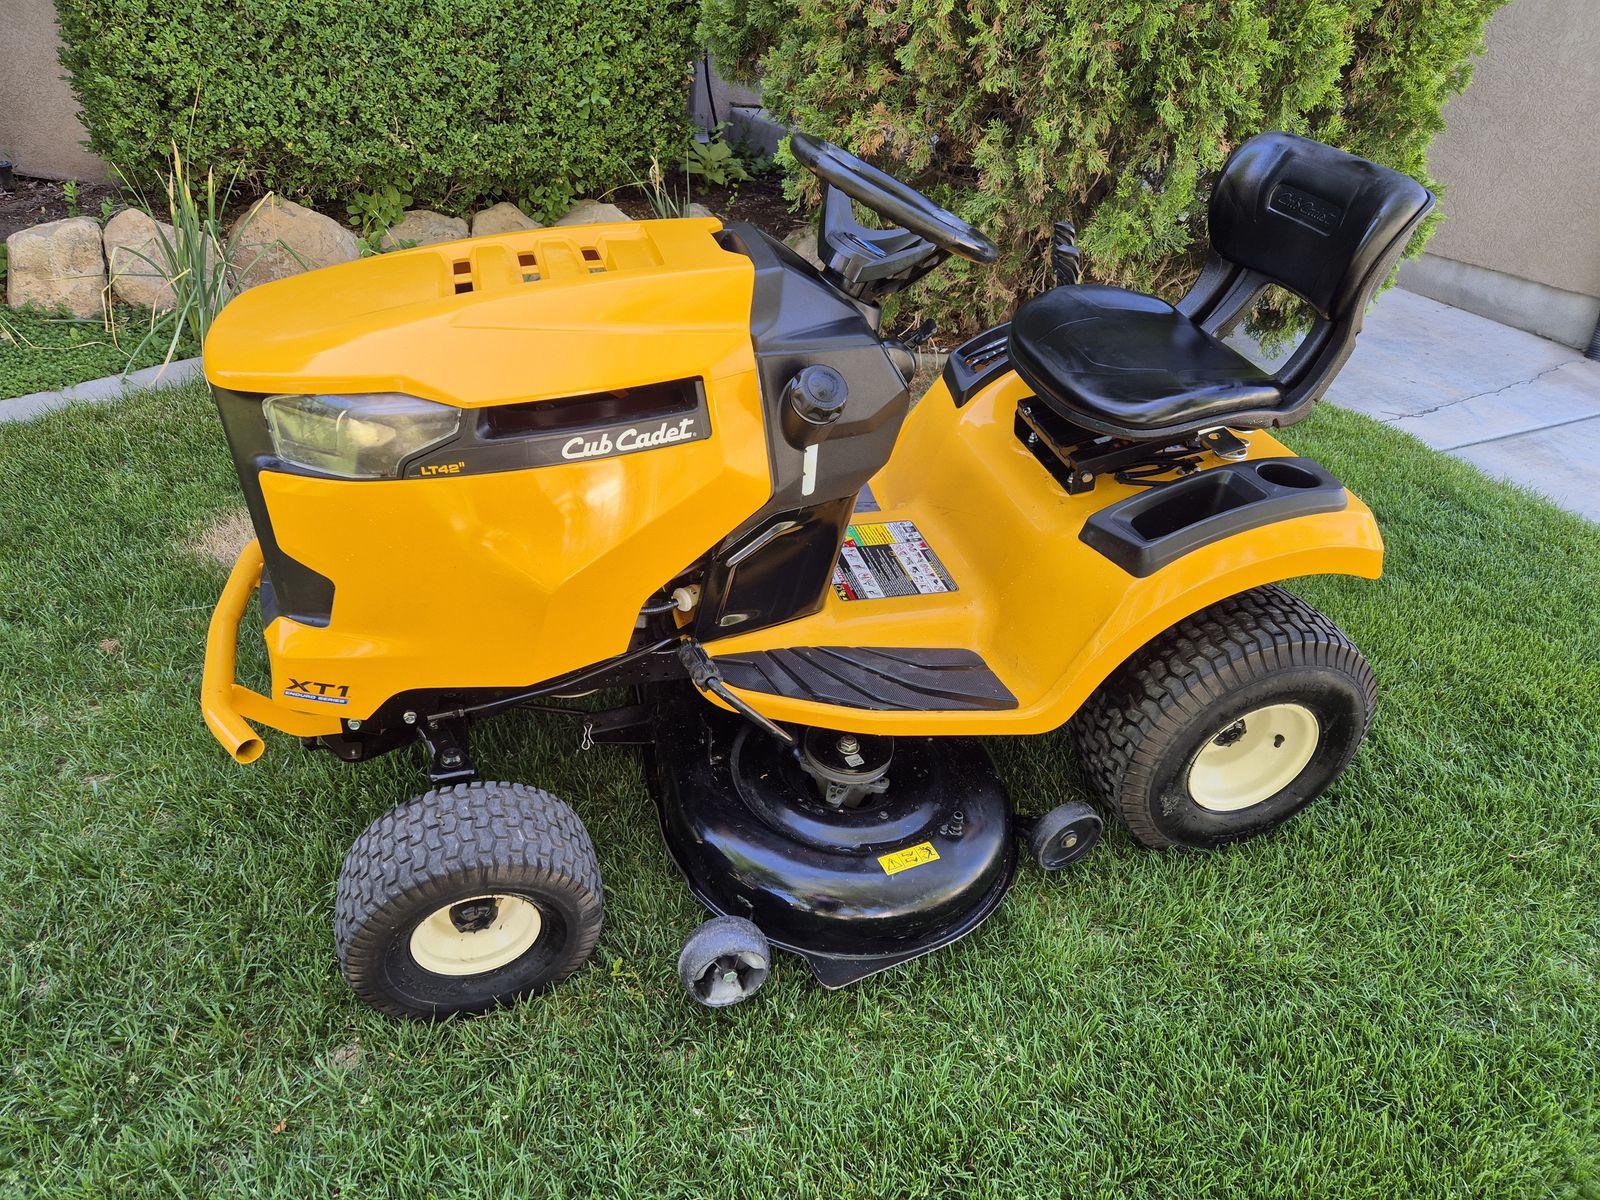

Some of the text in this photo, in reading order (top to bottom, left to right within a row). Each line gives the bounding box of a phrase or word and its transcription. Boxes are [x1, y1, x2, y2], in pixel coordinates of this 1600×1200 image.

[561, 418, 694, 459] Cub Cadet
[420, 461, 465, 475] LT42"
[285, 678, 350, 697] XT1
